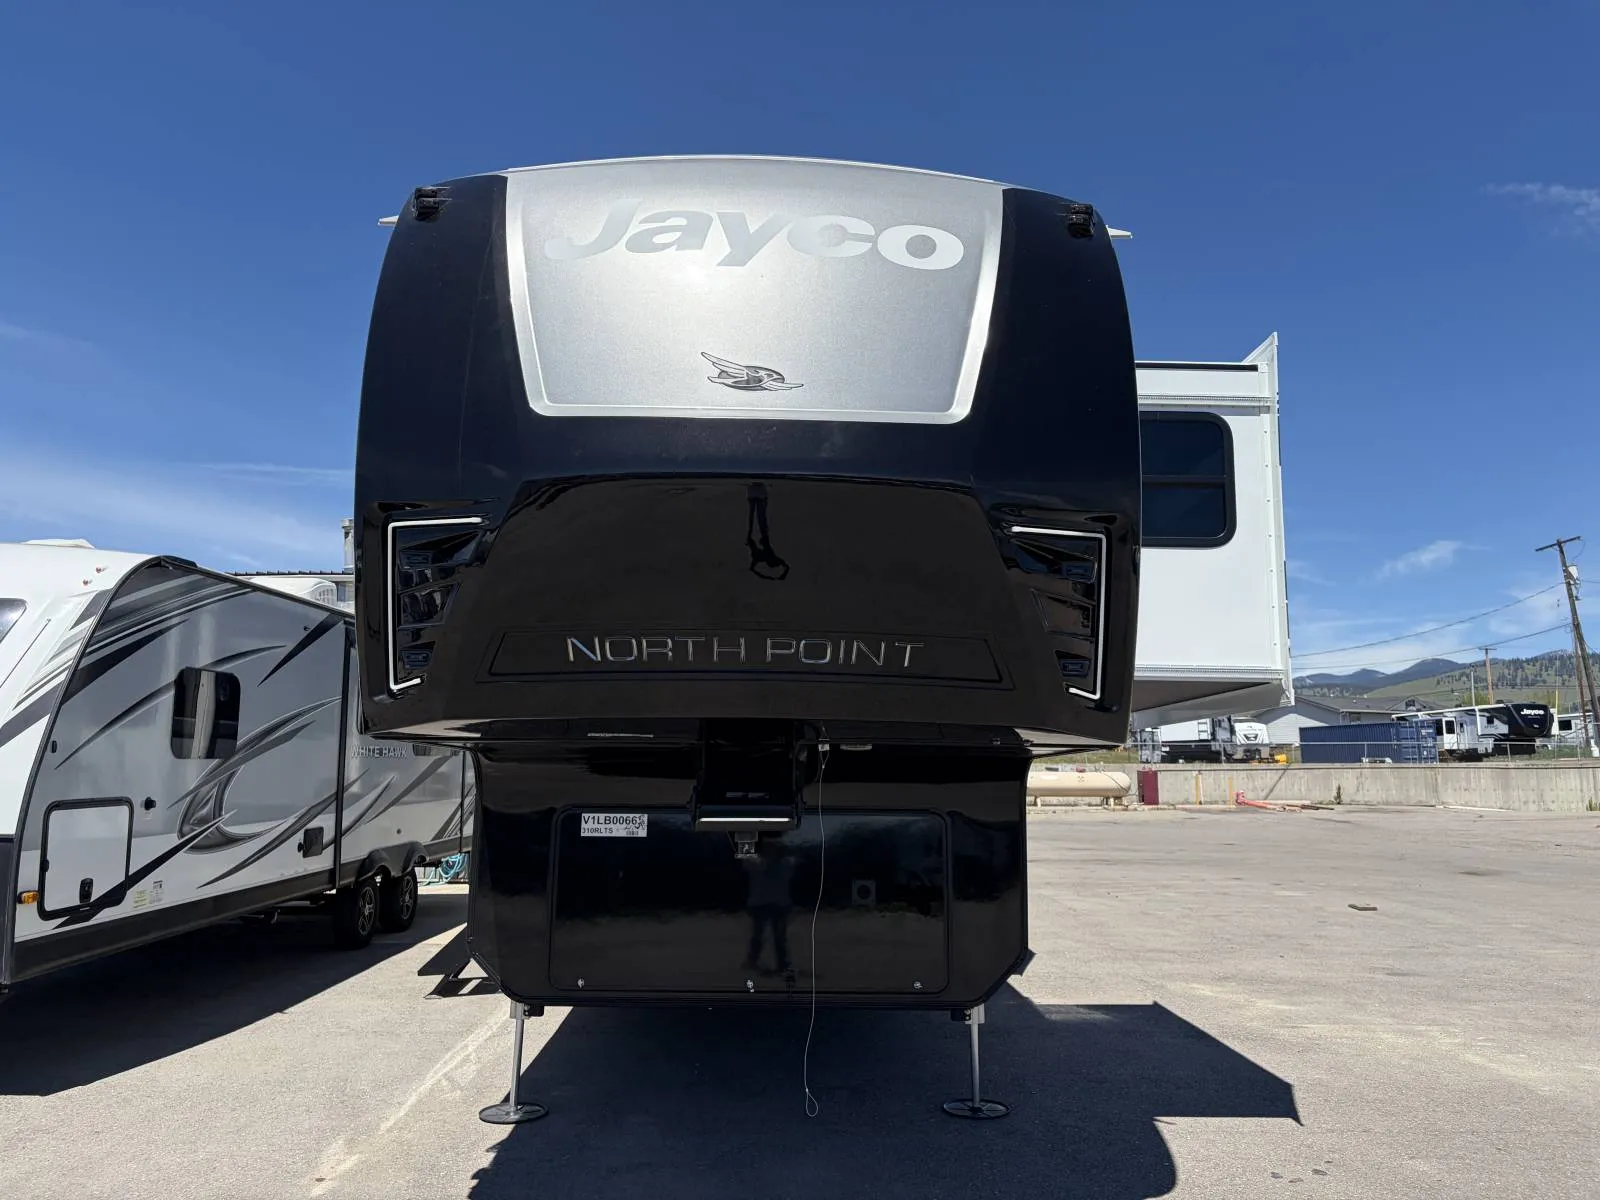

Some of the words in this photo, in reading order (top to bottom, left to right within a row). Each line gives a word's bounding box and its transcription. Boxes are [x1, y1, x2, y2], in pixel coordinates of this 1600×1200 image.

[544, 198, 965, 270] Jayco
[567, 635, 745, 663] NORTH
[765, 637, 924, 668] POINT
[351, 744, 381, 758] WHITE
[382, 745, 408, 758] HAWK
